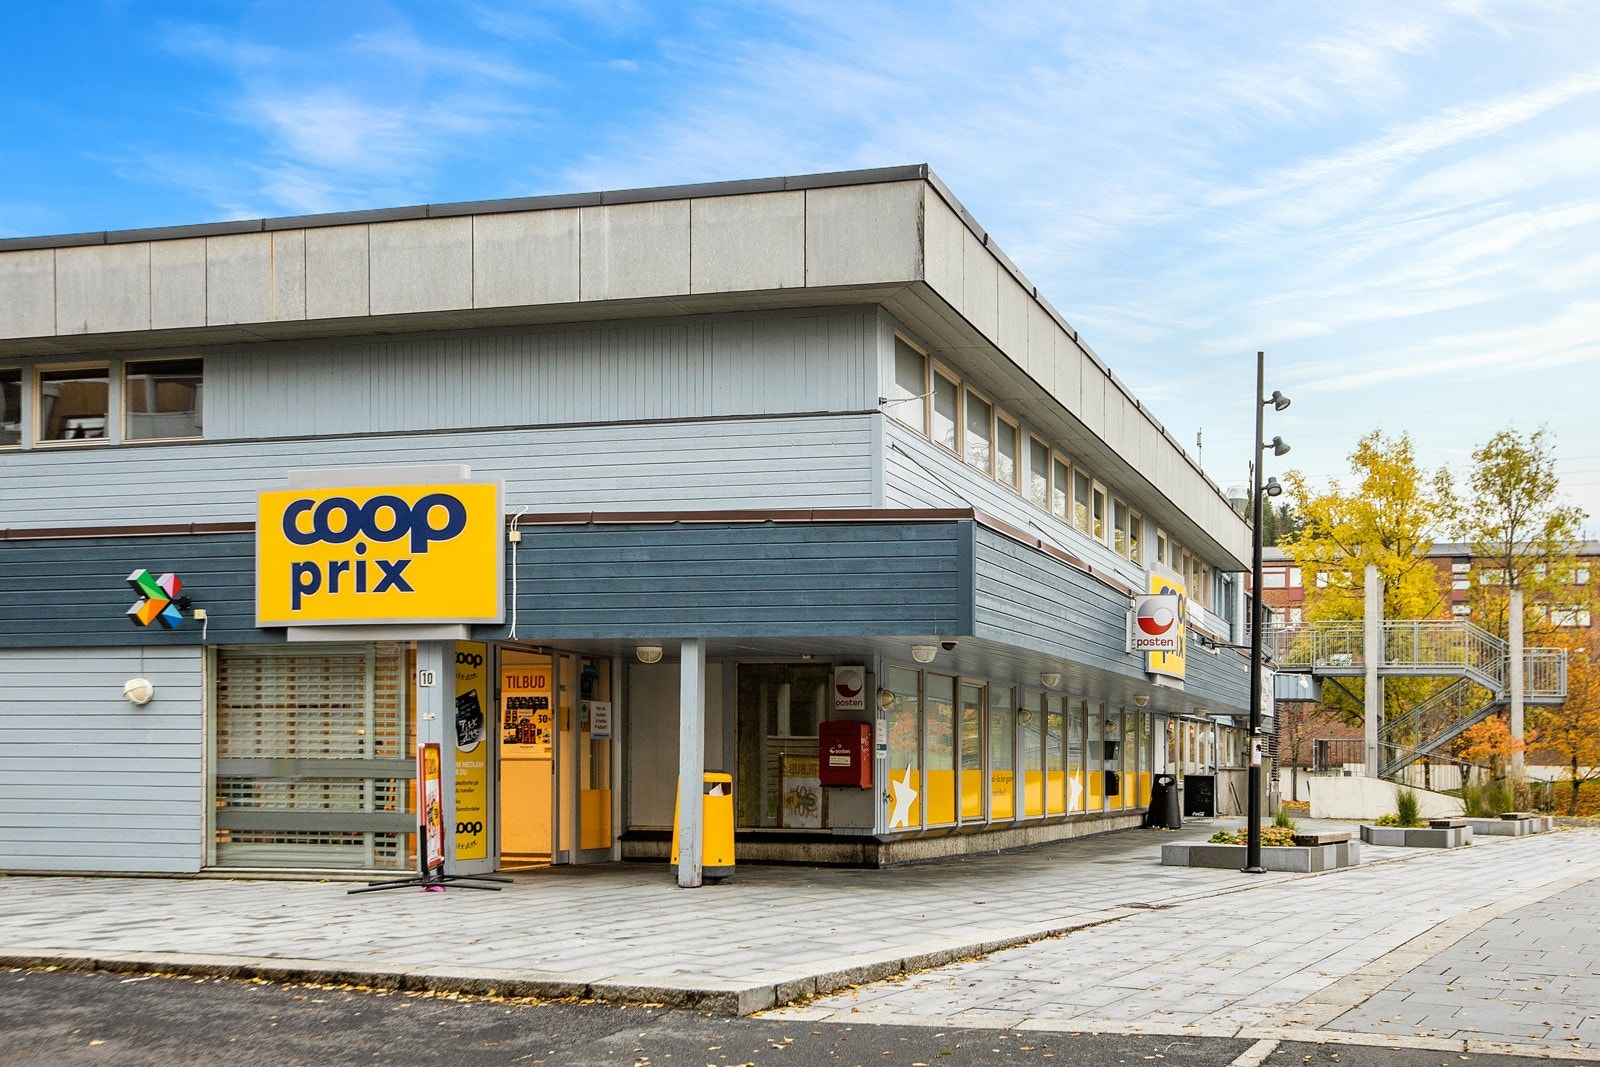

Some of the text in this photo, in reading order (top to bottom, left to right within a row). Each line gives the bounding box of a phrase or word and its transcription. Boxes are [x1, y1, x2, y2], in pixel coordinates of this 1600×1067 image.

[283, 493, 467, 554] coop
[291, 541, 415, 611] prix
[1137, 637, 1174, 647] posten
[455, 651, 483, 668] oop
[422, 672, 433, 685] 10
[506, 675, 545, 689] TILBUD
[836, 699, 863, 707] posten
[455, 821, 483, 837] oop
